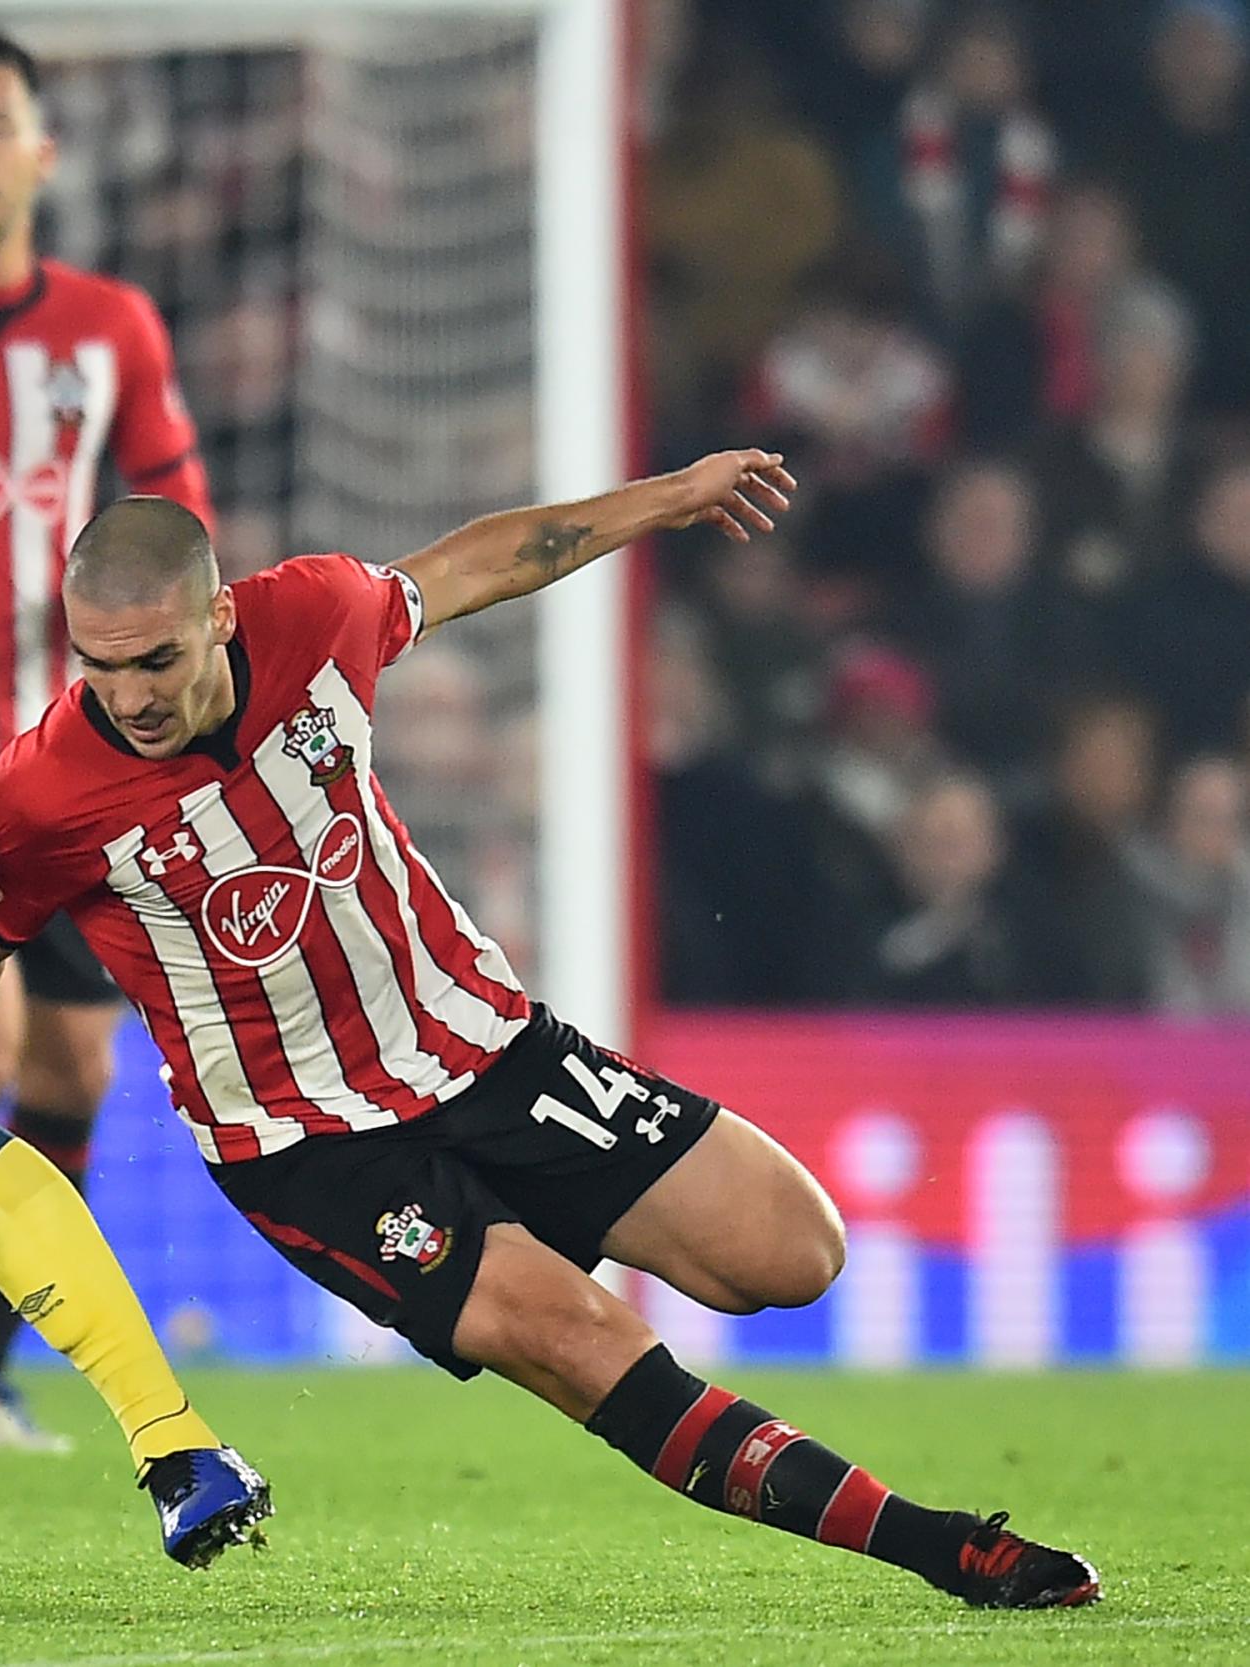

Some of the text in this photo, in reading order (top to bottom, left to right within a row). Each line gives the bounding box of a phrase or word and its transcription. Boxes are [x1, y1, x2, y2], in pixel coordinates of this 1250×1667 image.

[221, 833, 357, 947] Virgin media
[529, 1052, 651, 1150] 14
